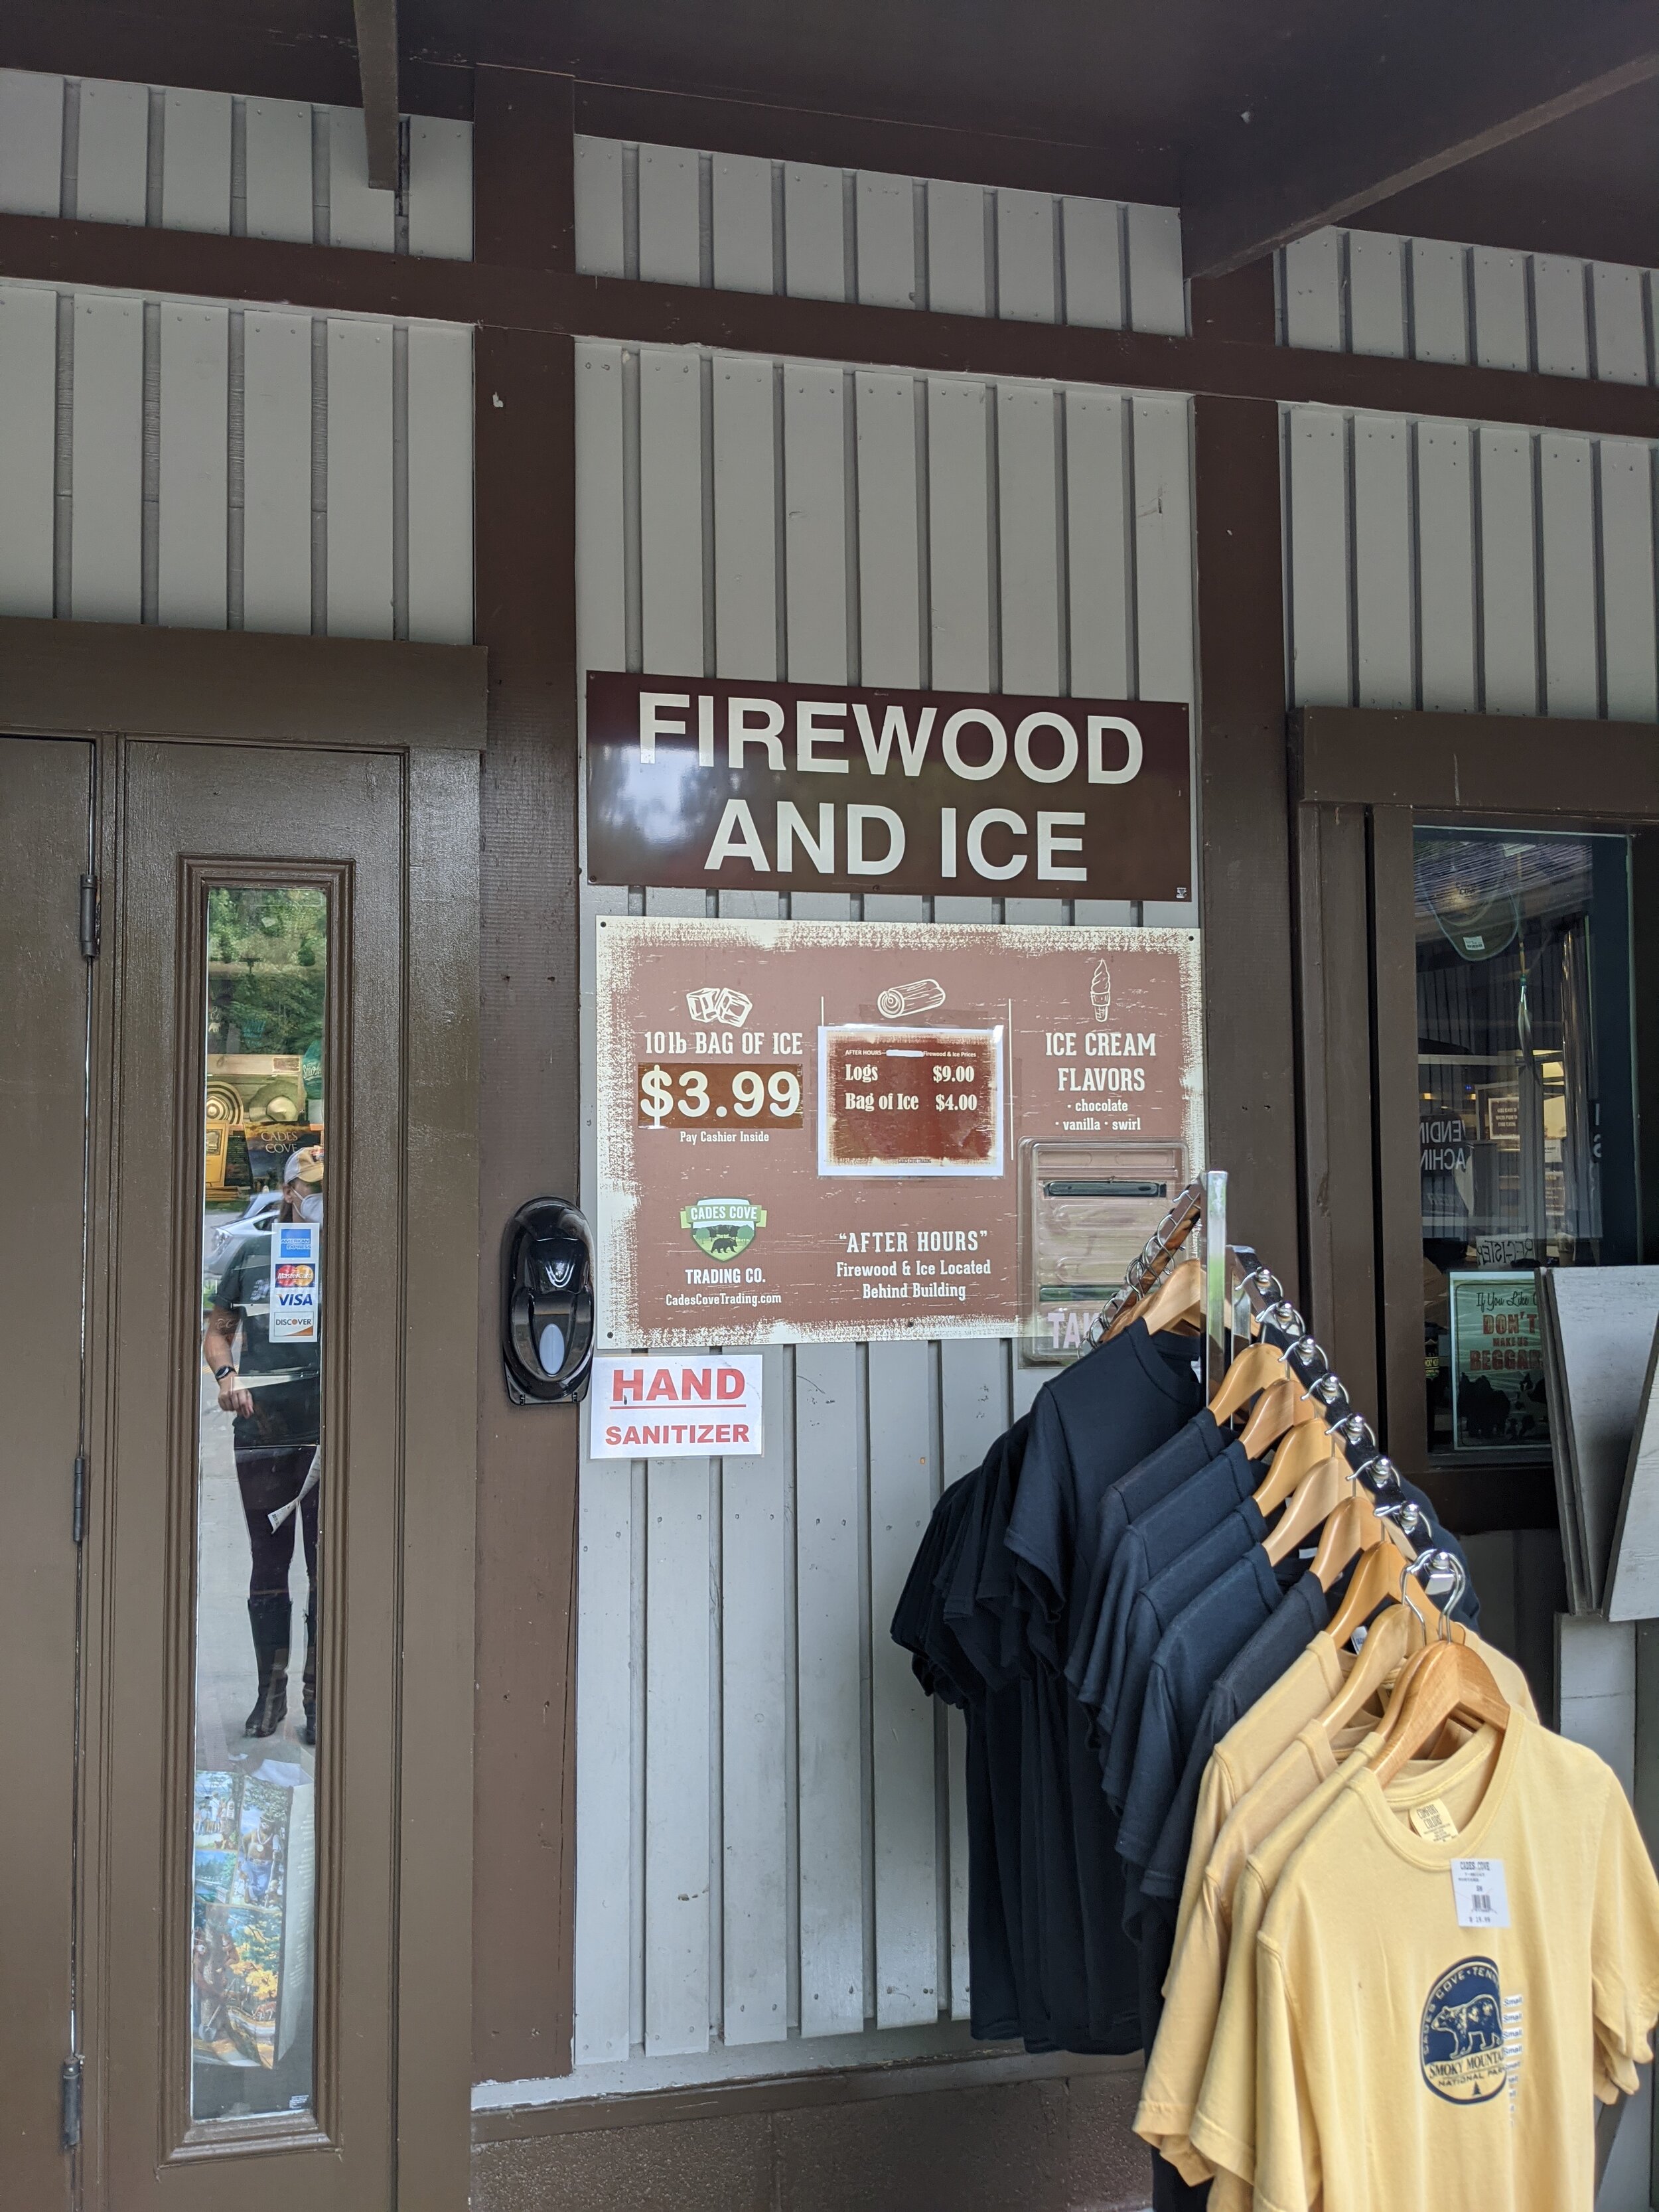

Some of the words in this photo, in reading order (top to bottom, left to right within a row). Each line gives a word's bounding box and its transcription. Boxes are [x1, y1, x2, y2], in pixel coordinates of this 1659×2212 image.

[639, 692, 1143, 784] FIREWOOD
[703, 798, 906, 875] AND
[941, 807, 1088, 881] ICE
[695, 1031, 733, 1055] BAG
[742, 1032, 764, 1054] OF
[773, 1032, 803, 1055] ICE
[1046, 1033, 1077, 1056] ICE
[1085, 1033, 1157, 1057] CREAM
[845, 1064, 878, 1082] Logs
[932, 1065, 975, 1082] $9.00
[1058, 1067, 1145, 1092] FLAVORS
[640, 1065, 800, 1127] $3.99
[845, 1093, 875, 1112] Bag
[879, 1094, 893, 1110] of
[897, 1093, 919, 1110] Ice
[936, 1094, 977, 1112] $4.00
[1075, 1098, 1129, 1112] chocolate
[1062, 1118, 1101, 1130] vanilla
[1112, 1117, 1141, 1130] swirl
[261, 1131, 298, 1142] CADES
[680, 1131, 697, 1145] Pay
[700, 1131, 737, 1142] Cashier
[740, 1131, 770, 1142] Inside
[265, 1143, 297, 1153] COVE
[691, 1206, 726, 1220] CADES
[729, 1206, 758, 1220] COVE
[685, 1268, 741, 1284] TRADING
[745, 1268, 766, 1284] CO.
[836, 1261, 897, 1277] Firewood
[902, 1260, 911, 1276] &
[916, 1260, 936, 1276] Ice
[940, 1260, 991, 1276] Located
[279, 1293, 313, 1306] VISA
[666, 1293, 782, 1307] CadesCoveTrading.com
[863, 1283, 908, 1299] Behind
[912, 1282, 966, 1301] Building
[1476, 1292, 1486, 1313] If
[1486, 1291, 1505, 1311] You
[1506, 1291, 1530, 1307] Like
[1482, 1311, 1538, 1335] DON'T
[1492, 1337, 1516, 1347] MAKE
[1517, 1337, 1529, 1347] US
[613, 1368, 745, 1402] HAND
[605, 1424, 750, 1445] SANITIZER
[1460, 1861, 1475, 1870] CADES
[1477, 1861, 1490, 1871] COVE
[1435, 1970, 1465, 2000] COVE
[1429, 2061, 1463, 2079] SMOKY
[1438, 2073, 1484, 2086] NATIONAL
